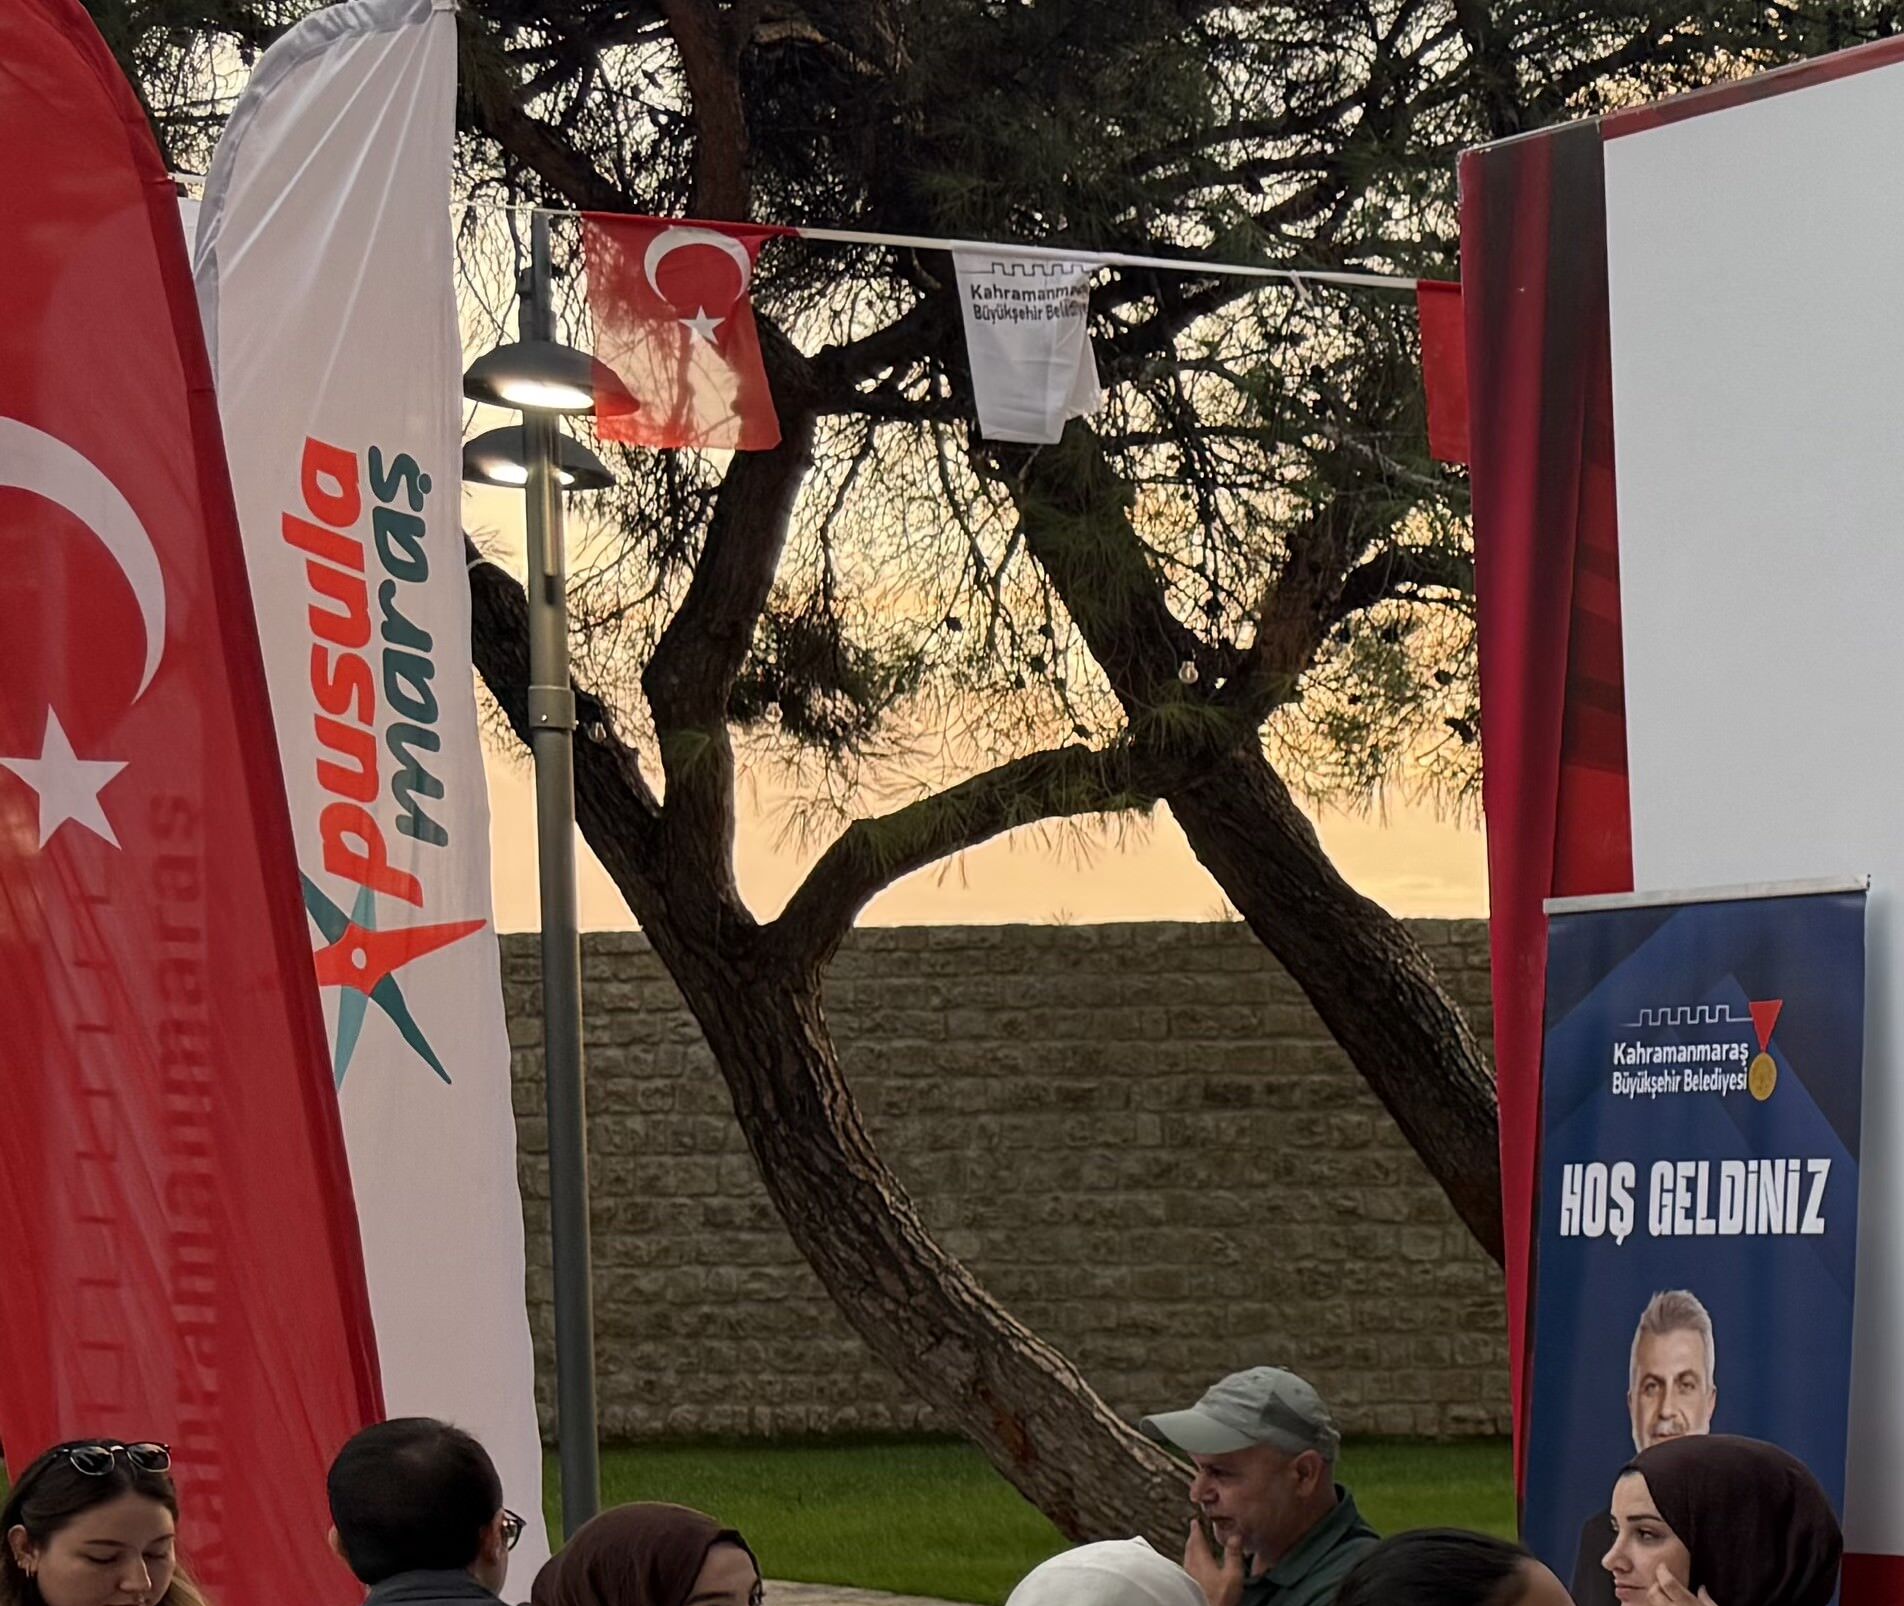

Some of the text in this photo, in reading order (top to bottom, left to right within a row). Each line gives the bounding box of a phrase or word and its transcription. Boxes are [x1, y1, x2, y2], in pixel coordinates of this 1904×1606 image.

[973, 303, 1043, 325] Büyükşehir
[282, 435, 424, 908] pusula
[369, 445, 449, 847] maraş
[1612, 1066, 1748, 1101] Büyükşehir Belediyesi
[1613, 1041, 1750, 1068] Kahramanmaraş
[1560, 1158, 1831, 1246] HOŞ GELDİNİZ
